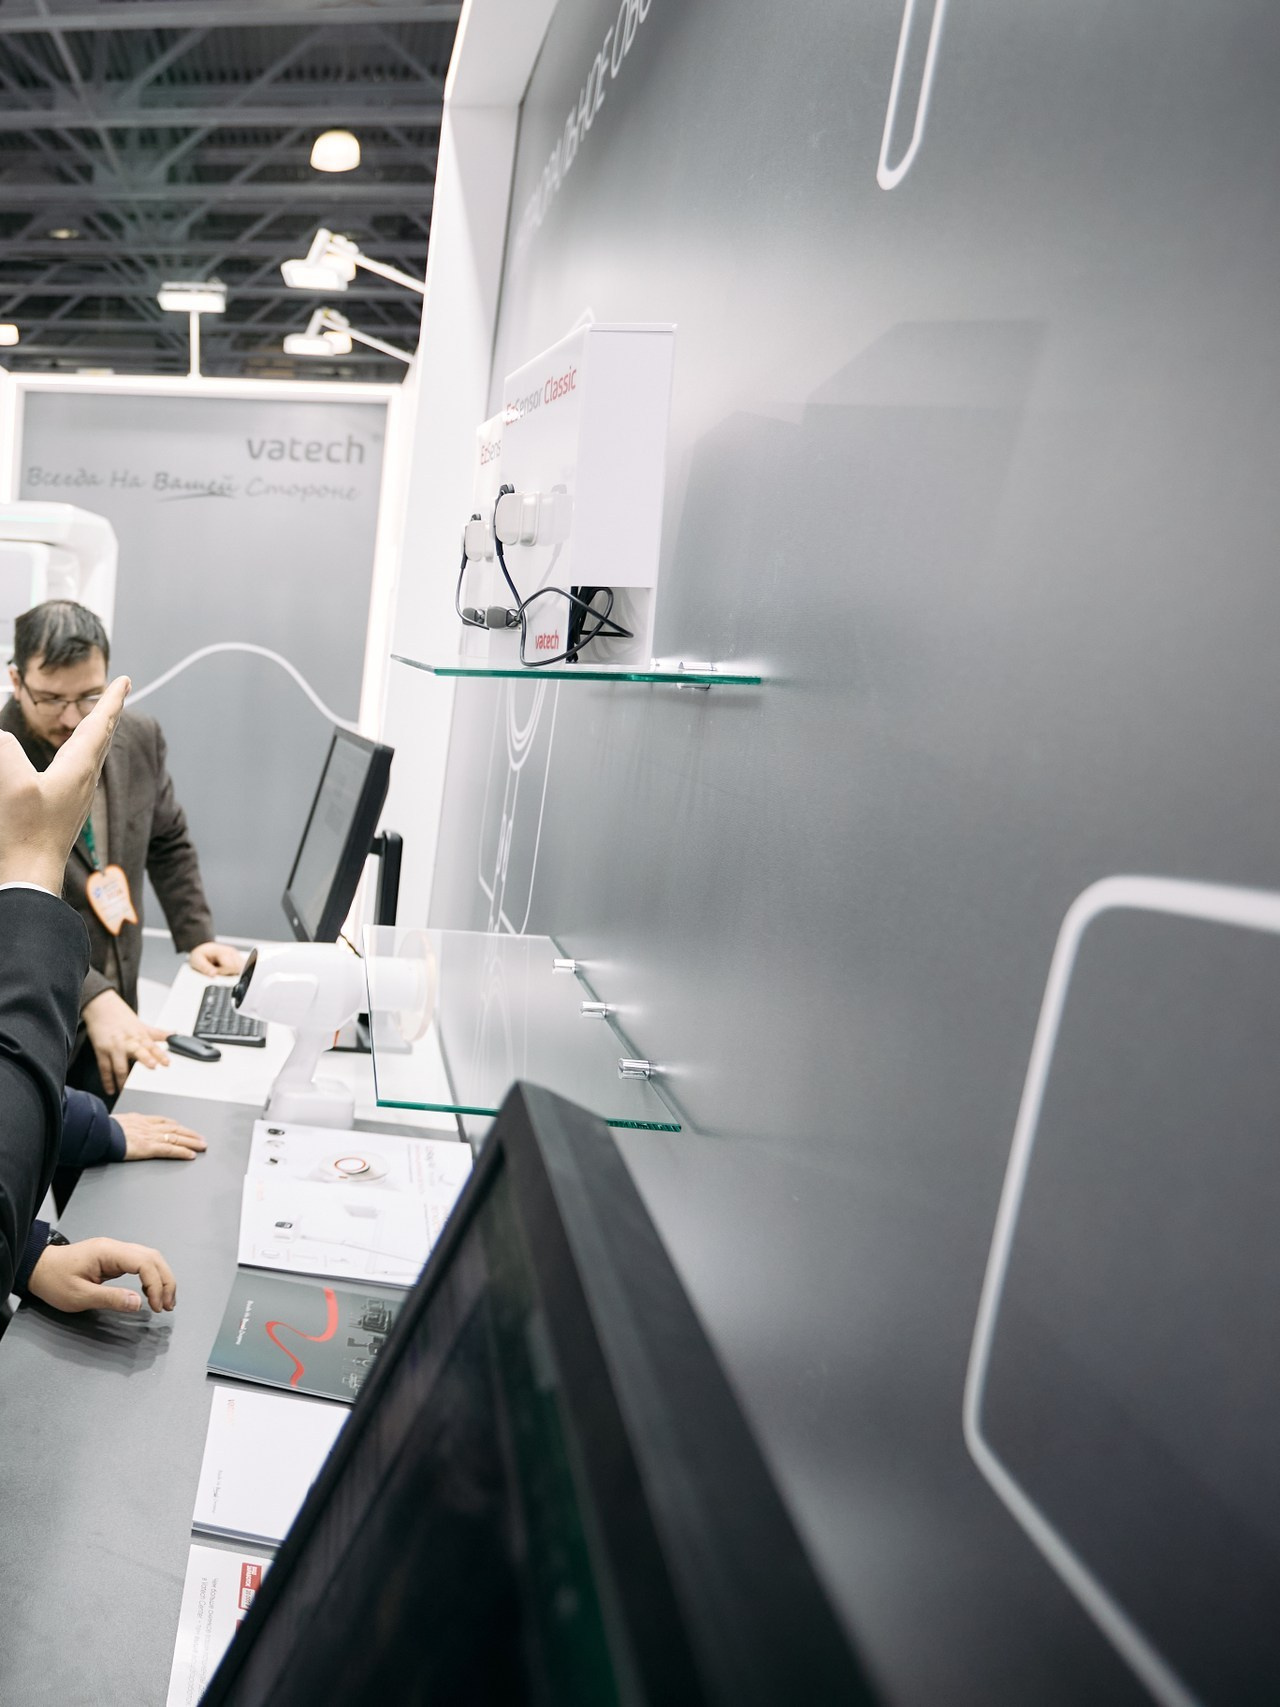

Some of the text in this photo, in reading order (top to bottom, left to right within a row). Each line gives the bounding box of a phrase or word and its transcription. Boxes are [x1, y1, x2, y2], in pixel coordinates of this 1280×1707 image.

[543, 364, 577, 404] Classic
[245, 434, 366, 465] vatech
[535, 629, 560, 650] vatech
